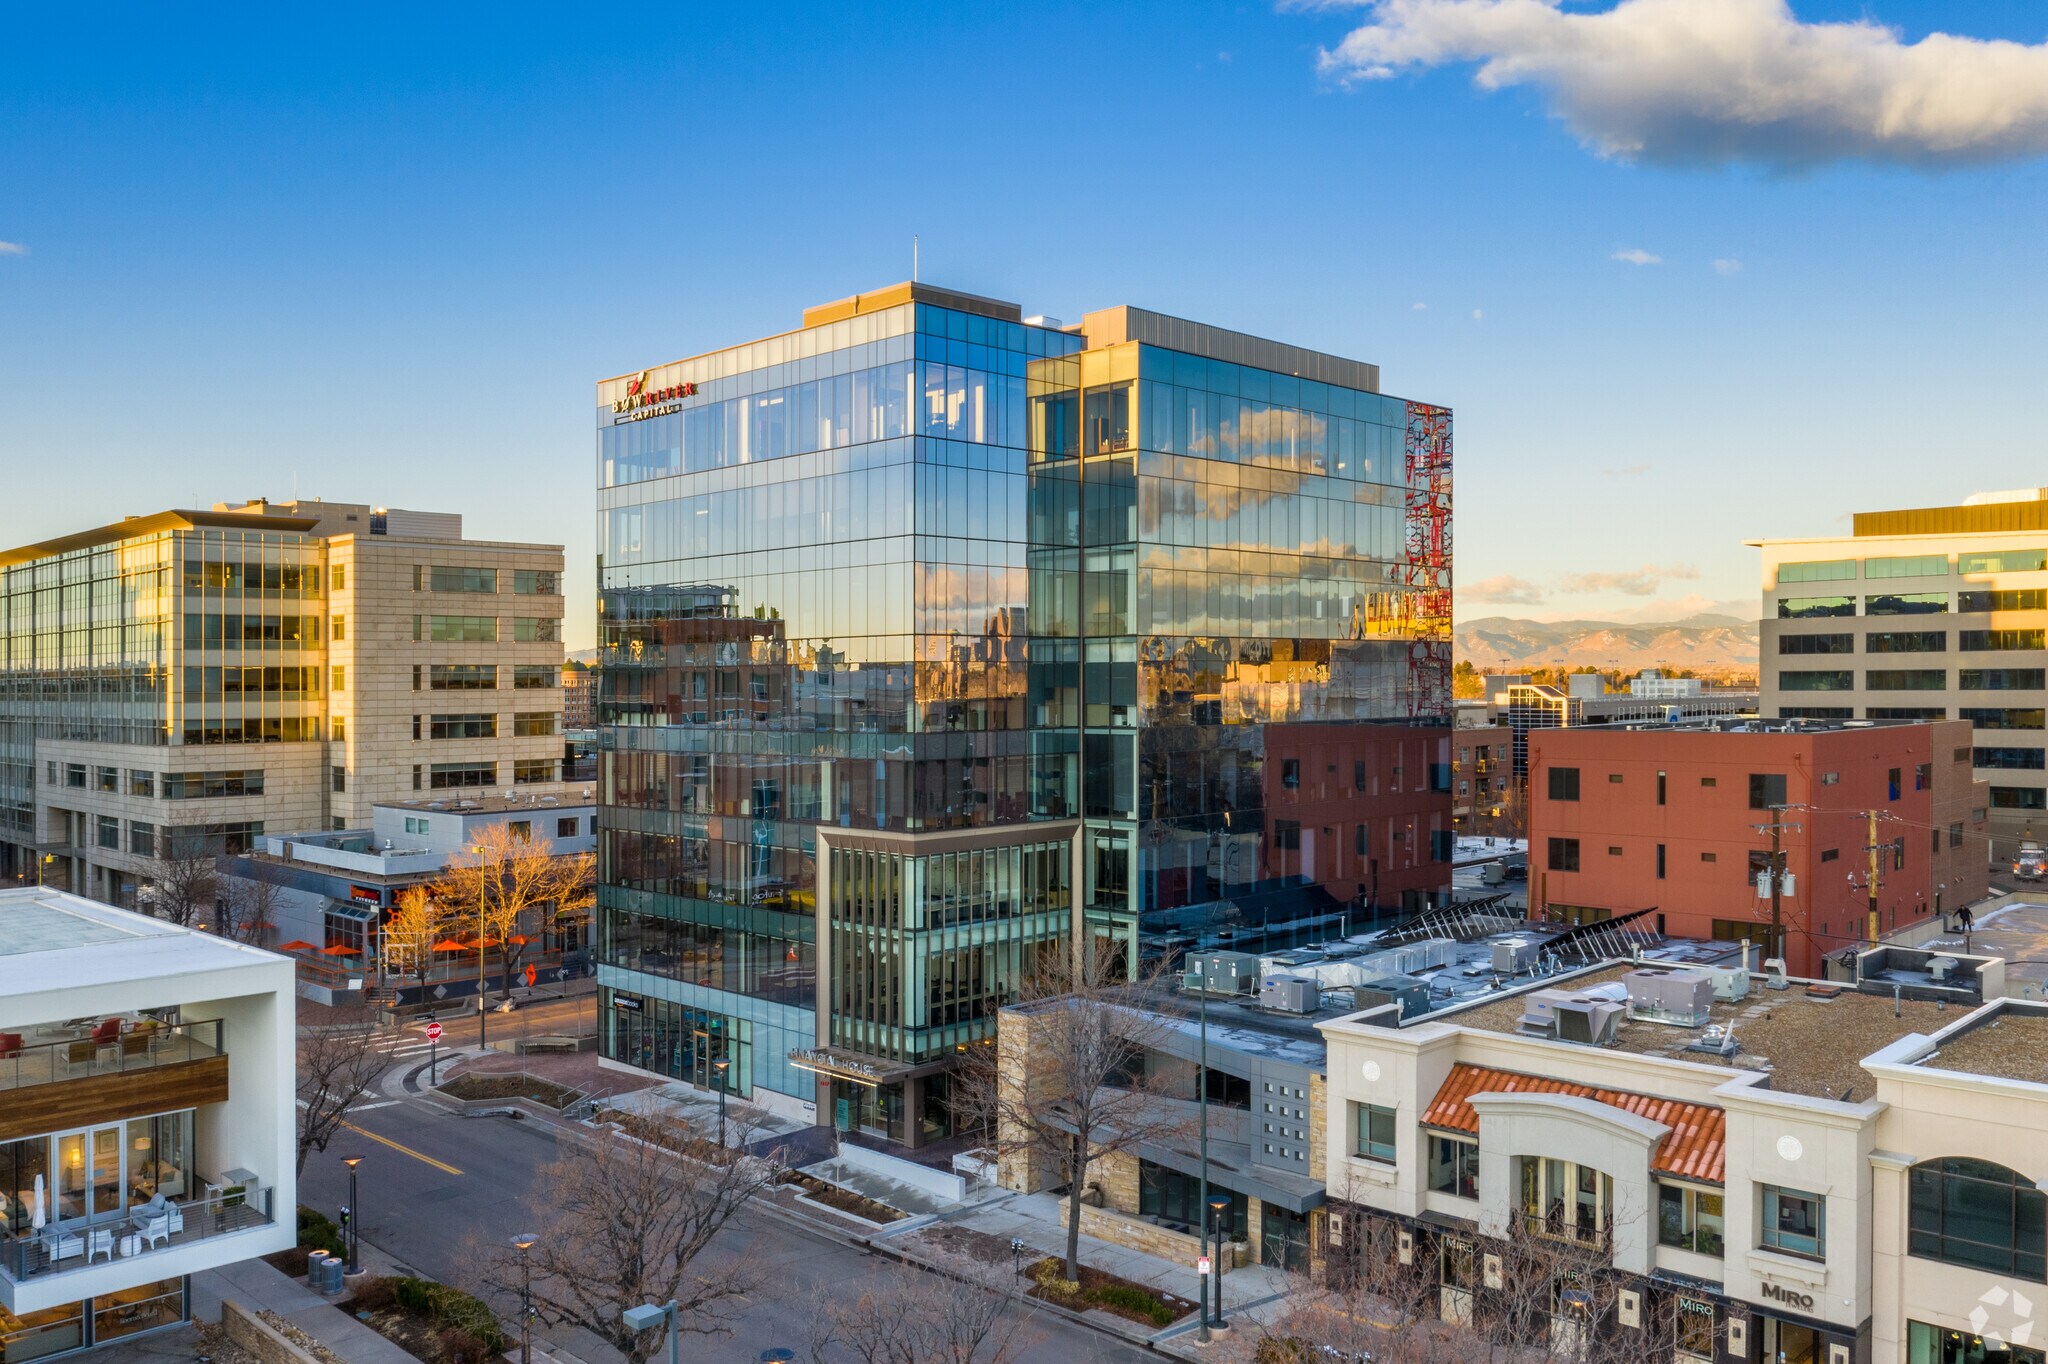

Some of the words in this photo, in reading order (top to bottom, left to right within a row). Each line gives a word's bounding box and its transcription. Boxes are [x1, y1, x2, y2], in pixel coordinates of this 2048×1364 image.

[630, 404, 673, 421] CAPITAL
[427, 1027, 442, 1035] STOP
[791, 1046, 837, 1068] FINANCIAL
[842, 1060, 875, 1078] HOUSE
[1761, 1282, 1814, 1307] MIRO
[1680, 1298, 1713, 1316] MIRO
